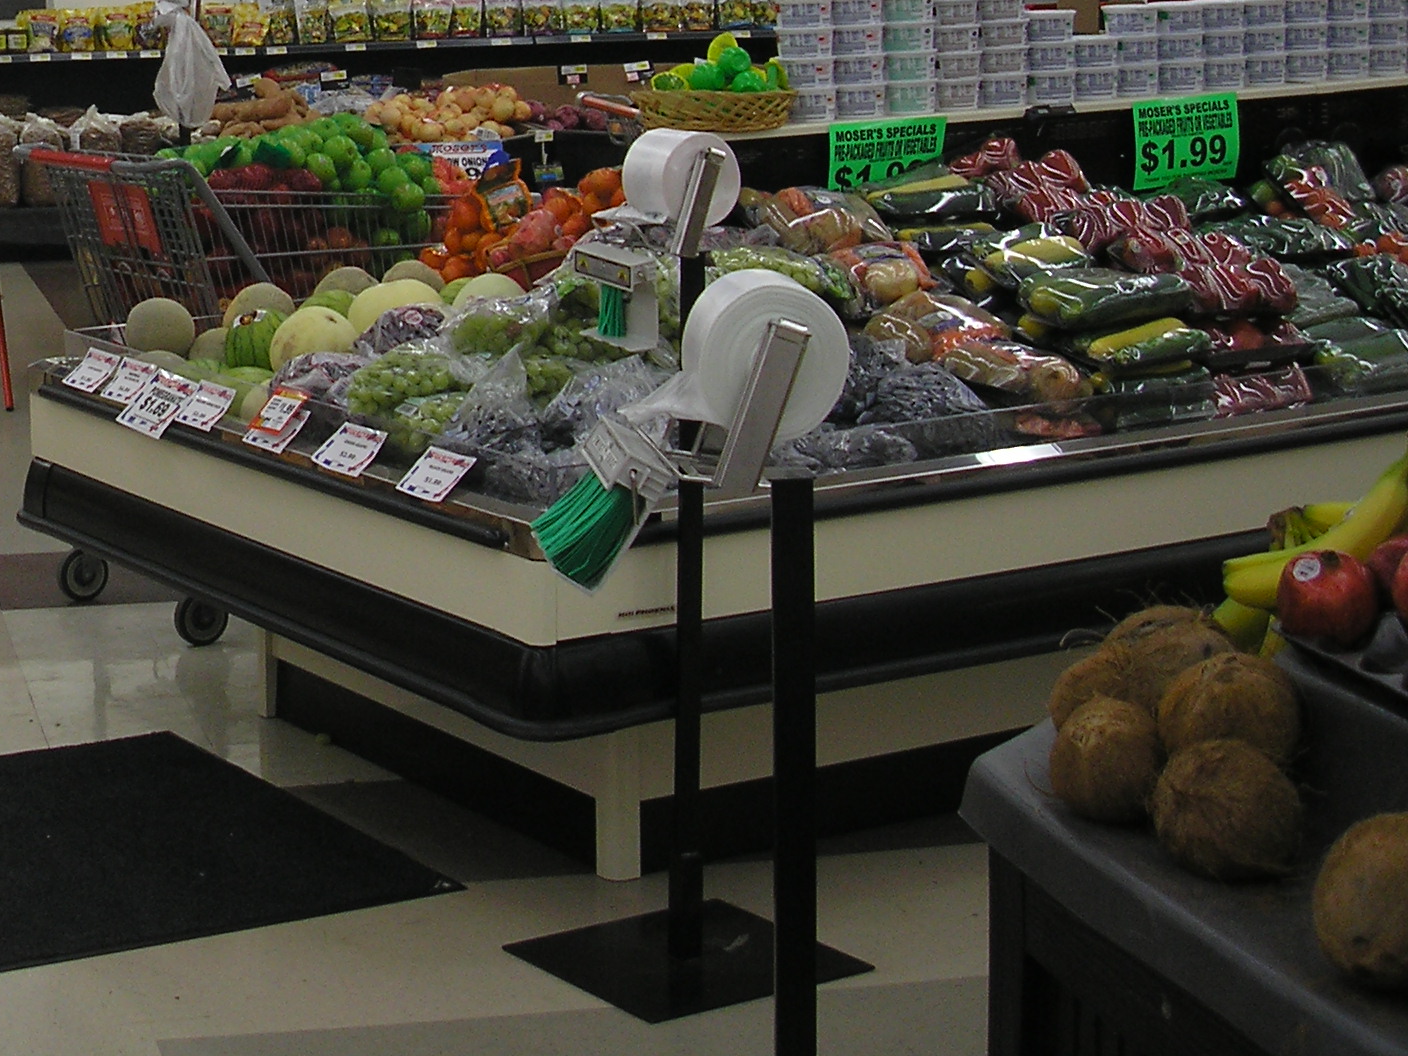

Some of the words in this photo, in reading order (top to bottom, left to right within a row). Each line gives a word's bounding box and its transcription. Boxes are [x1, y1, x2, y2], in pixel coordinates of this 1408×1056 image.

[1138, 104, 1182, 118] MOSER'S
[1184, 100, 1230, 114] SPECIALS
[836, 128, 884, 142] MOSER'S
[886, 124, 936, 138] SPECIALS
[1140, 134, 1227, 176] $1.99
[140, 396, 170, 417] $1.69
